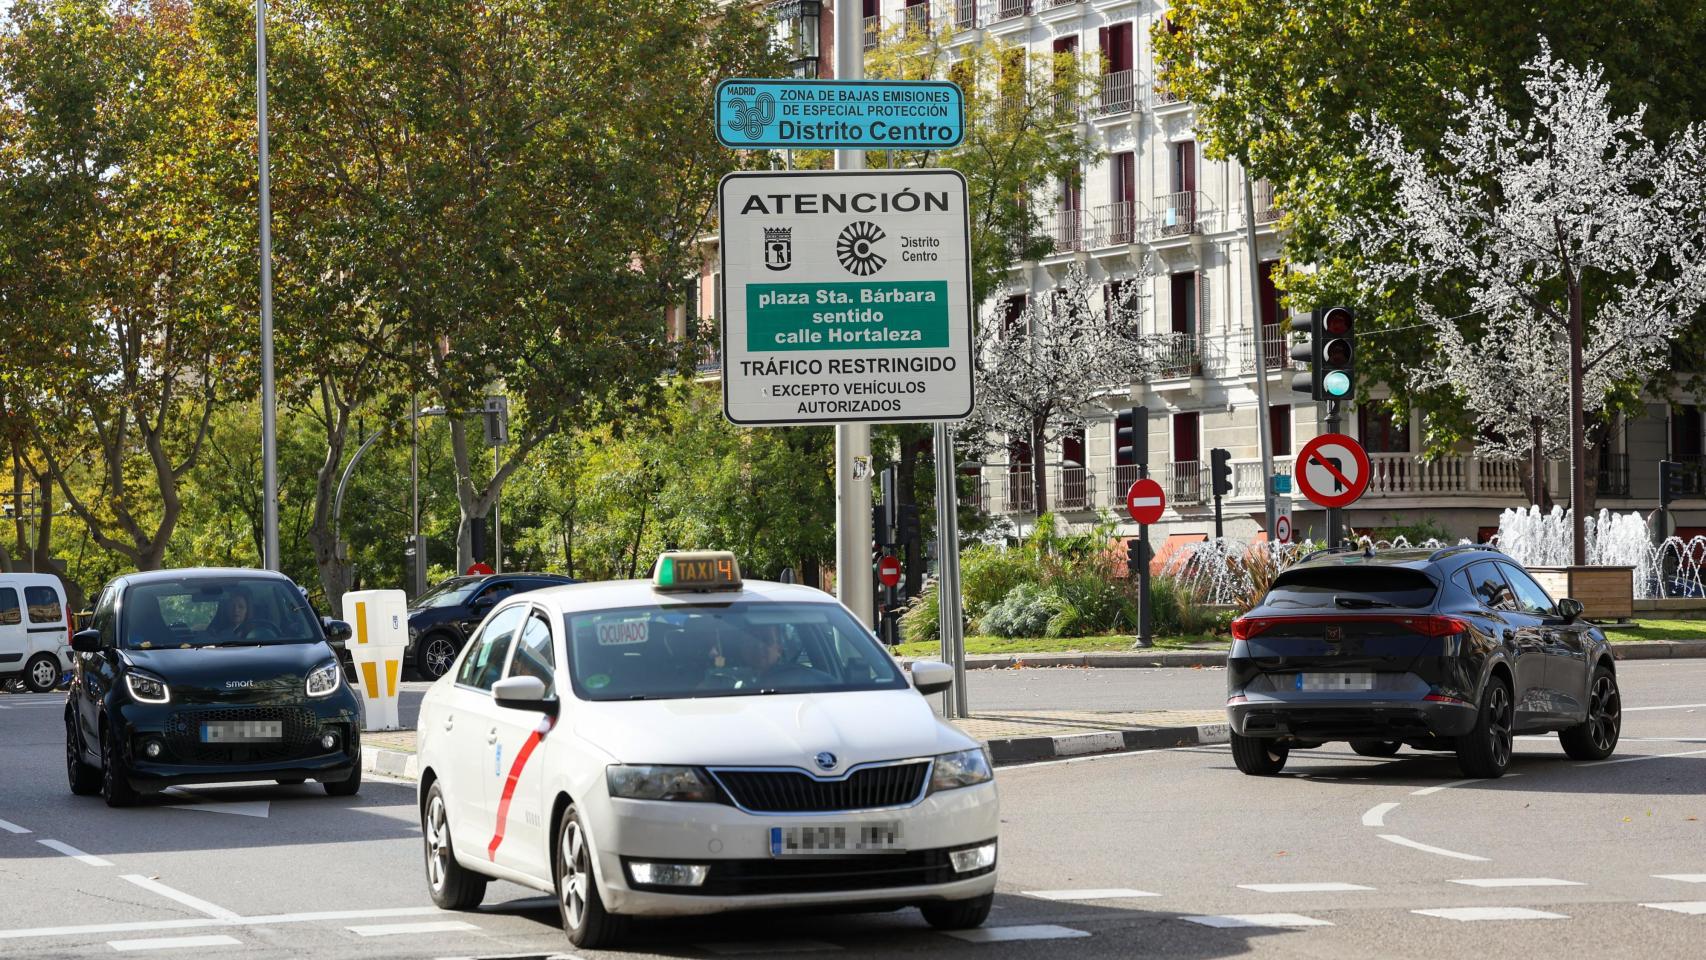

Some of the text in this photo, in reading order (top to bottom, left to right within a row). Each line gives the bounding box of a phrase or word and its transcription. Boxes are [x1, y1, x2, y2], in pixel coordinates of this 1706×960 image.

[727, 87, 756, 96] MADRID
[780, 90, 950, 103] ZONA DE BAJAS EMISIONES
[783, 103, 948, 117] DE ESPECIAL PROTECCIÓN
[779, 121, 953, 141] Distrito Centro
[740, 188, 949, 215] ATENCIÓN
[902, 251, 938, 262] Centro
[759, 288, 936, 308] plaza Sta. Bárbara
[812, 309, 884, 324] sentido
[774, 327, 922, 344] calle Hortaleza
[740, 356, 957, 377] TRÁFICO RESTRINGIDO
[772, 380, 927, 397] EXCEPTO VEHÍCULOS
[797, 399, 902, 414] AUTORIZADOS
[678, 559, 732, 581] TAXI 4
[601, 622, 646, 642] OCUPADO
[225, 680, 254, 688] smart
